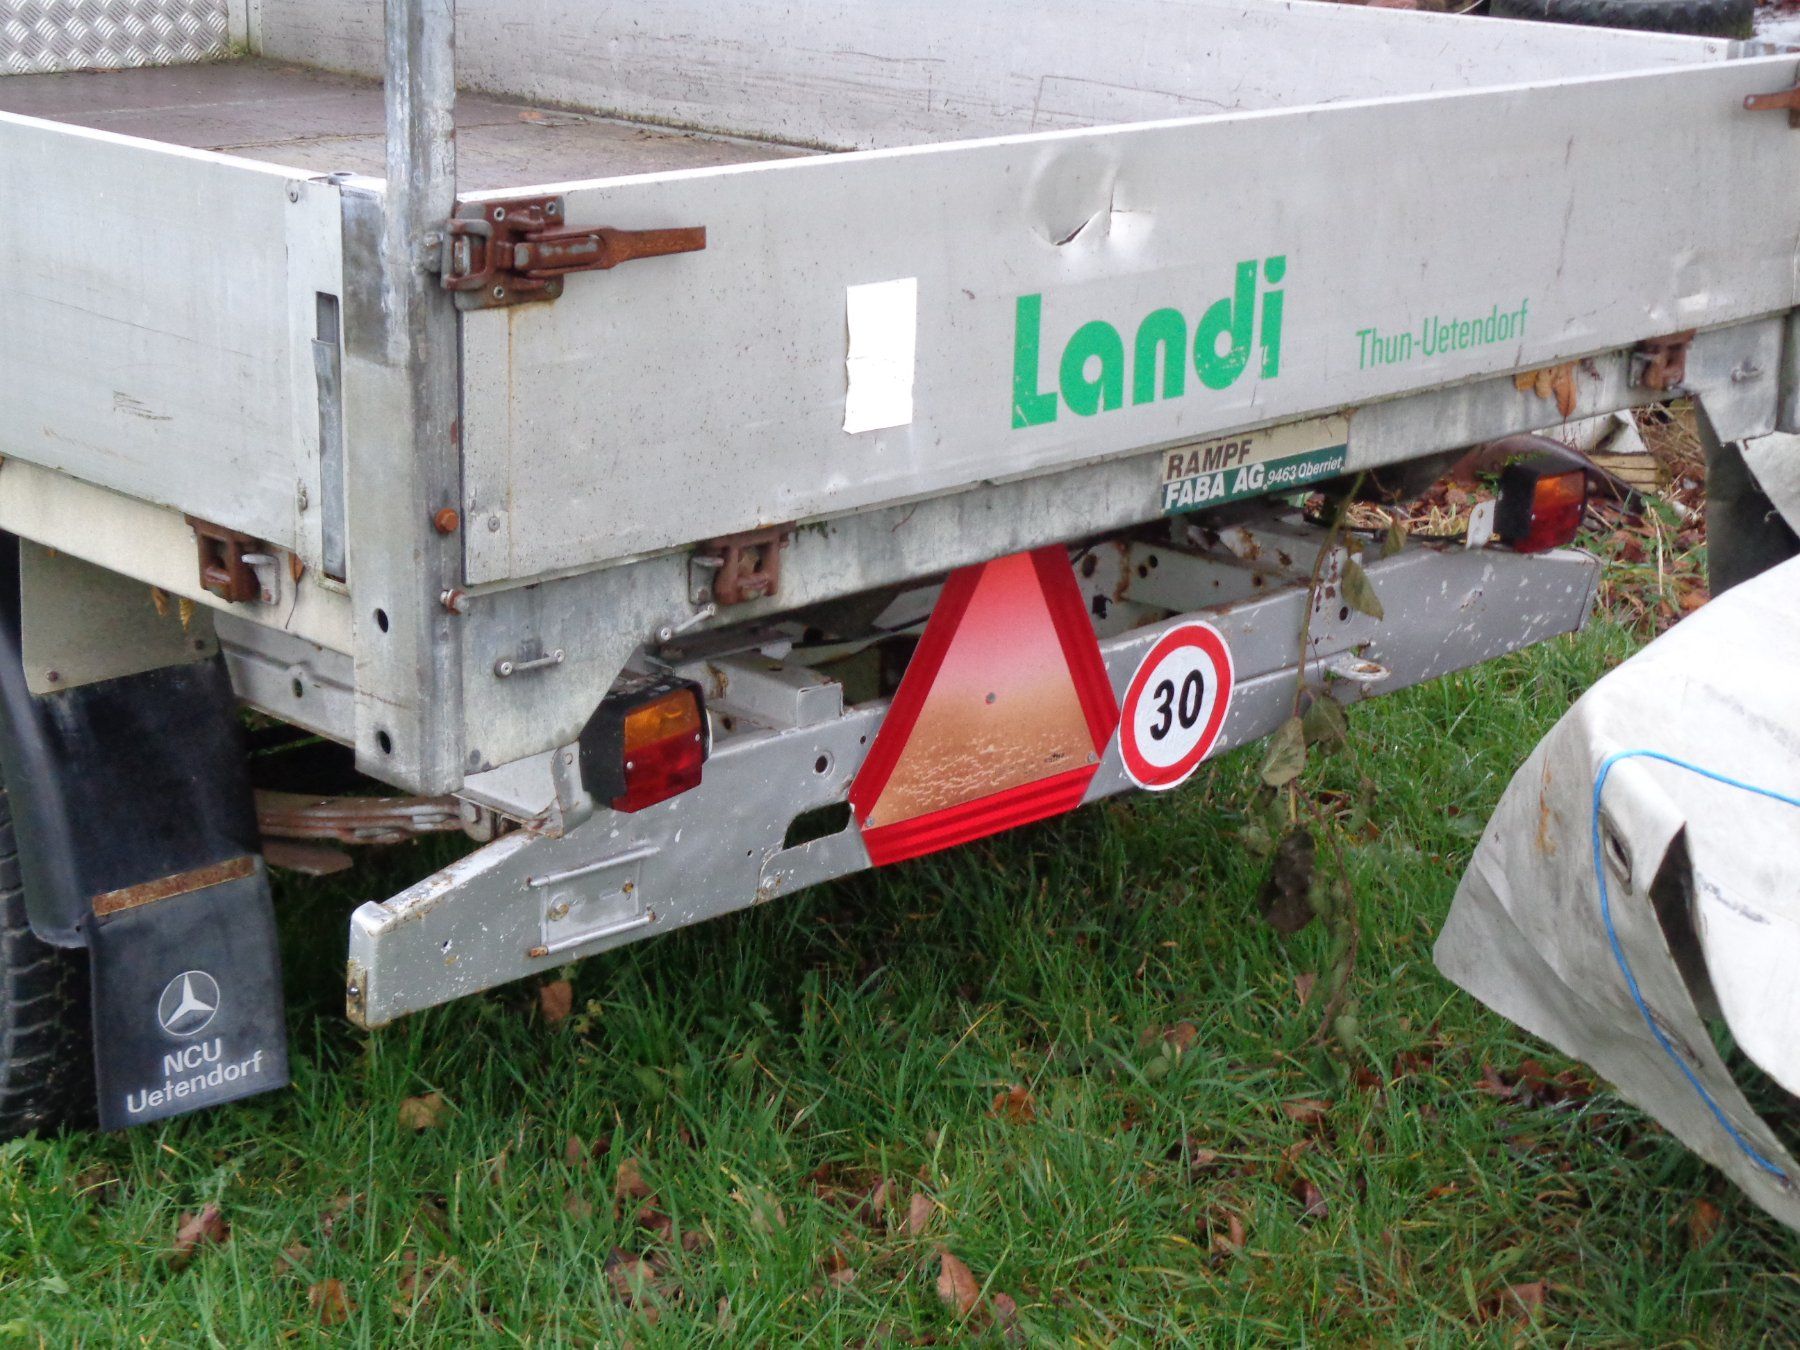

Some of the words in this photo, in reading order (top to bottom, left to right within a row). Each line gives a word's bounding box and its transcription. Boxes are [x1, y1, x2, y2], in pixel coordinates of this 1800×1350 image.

[1012, 255, 1286, 429] Landi
[1355, 297, 1529, 370] Thun-Uetendorf
[1164, 473, 1226, 510] FABA
[1231, 463, 1265, 494] AG
[1265, 464, 1297, 485] 9463
[1298, 456, 1343, 478] Oberriet
[1166, 439, 1252, 481] RAMPF
[1149, 668, 1205, 741] 30
[126, 1050, 263, 1114] Uetendorf
[163, 1038, 222, 1076] NCU
